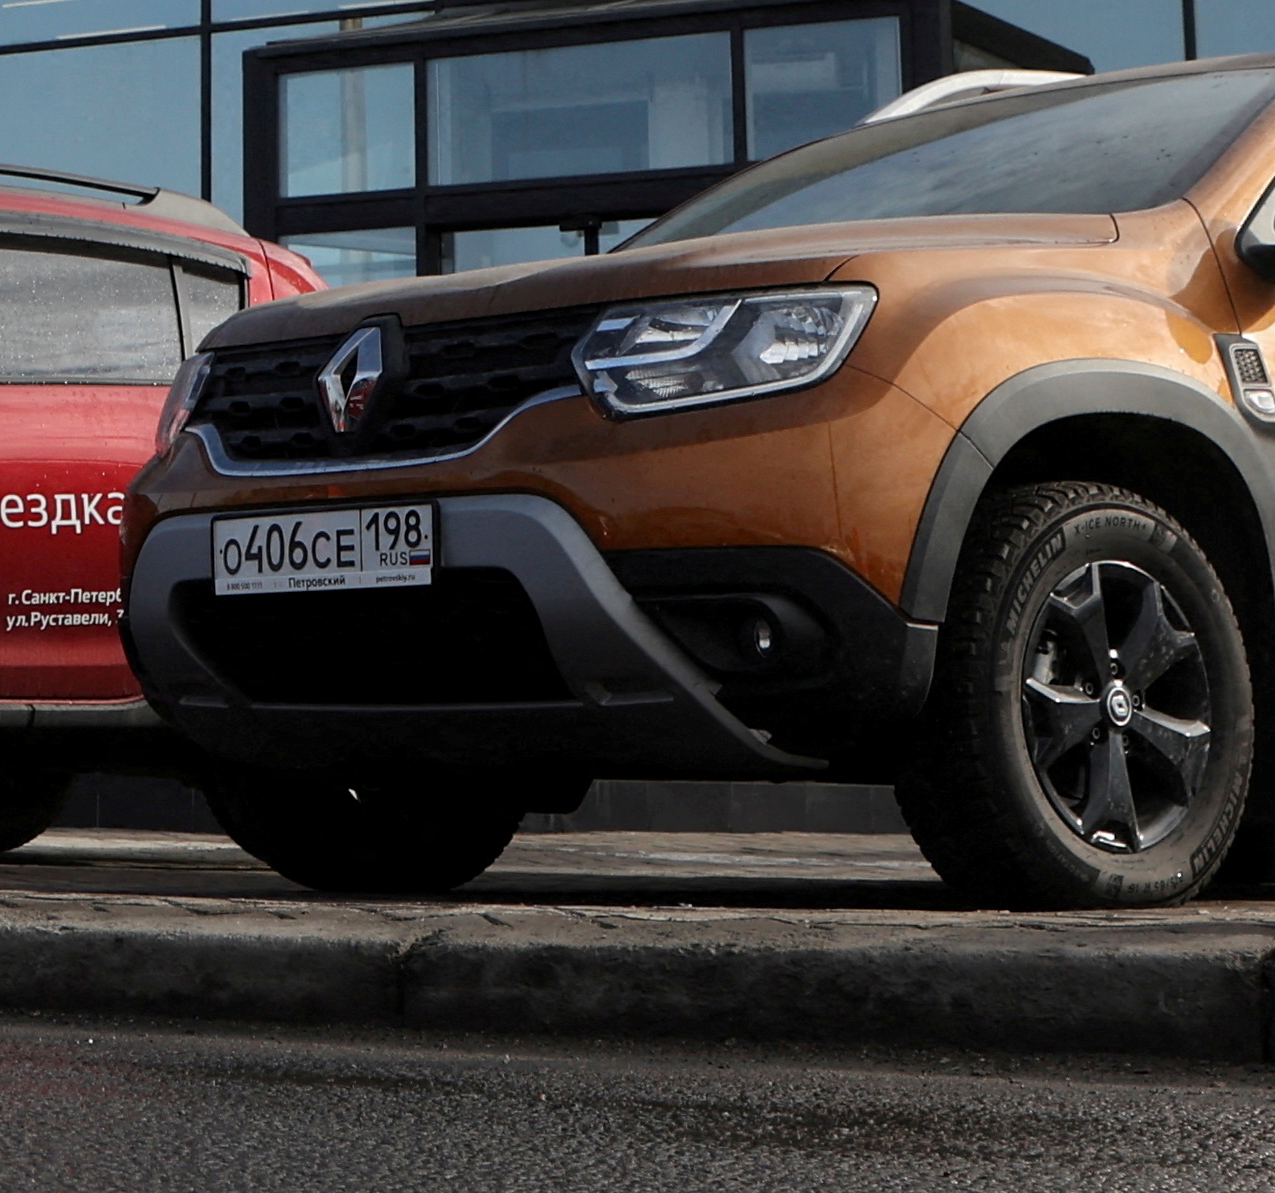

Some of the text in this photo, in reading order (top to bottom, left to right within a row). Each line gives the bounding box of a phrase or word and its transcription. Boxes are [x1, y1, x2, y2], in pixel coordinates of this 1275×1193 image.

[365, 509, 422, 551] 198
[379, 552, 408, 566] RUS
[288, 575, 346, 590] Петровский
[1006, 533, 1063, 635] MICHELIN
[8, 593, 19, 605] г.
[30, 612, 112, 630] Руставели,
